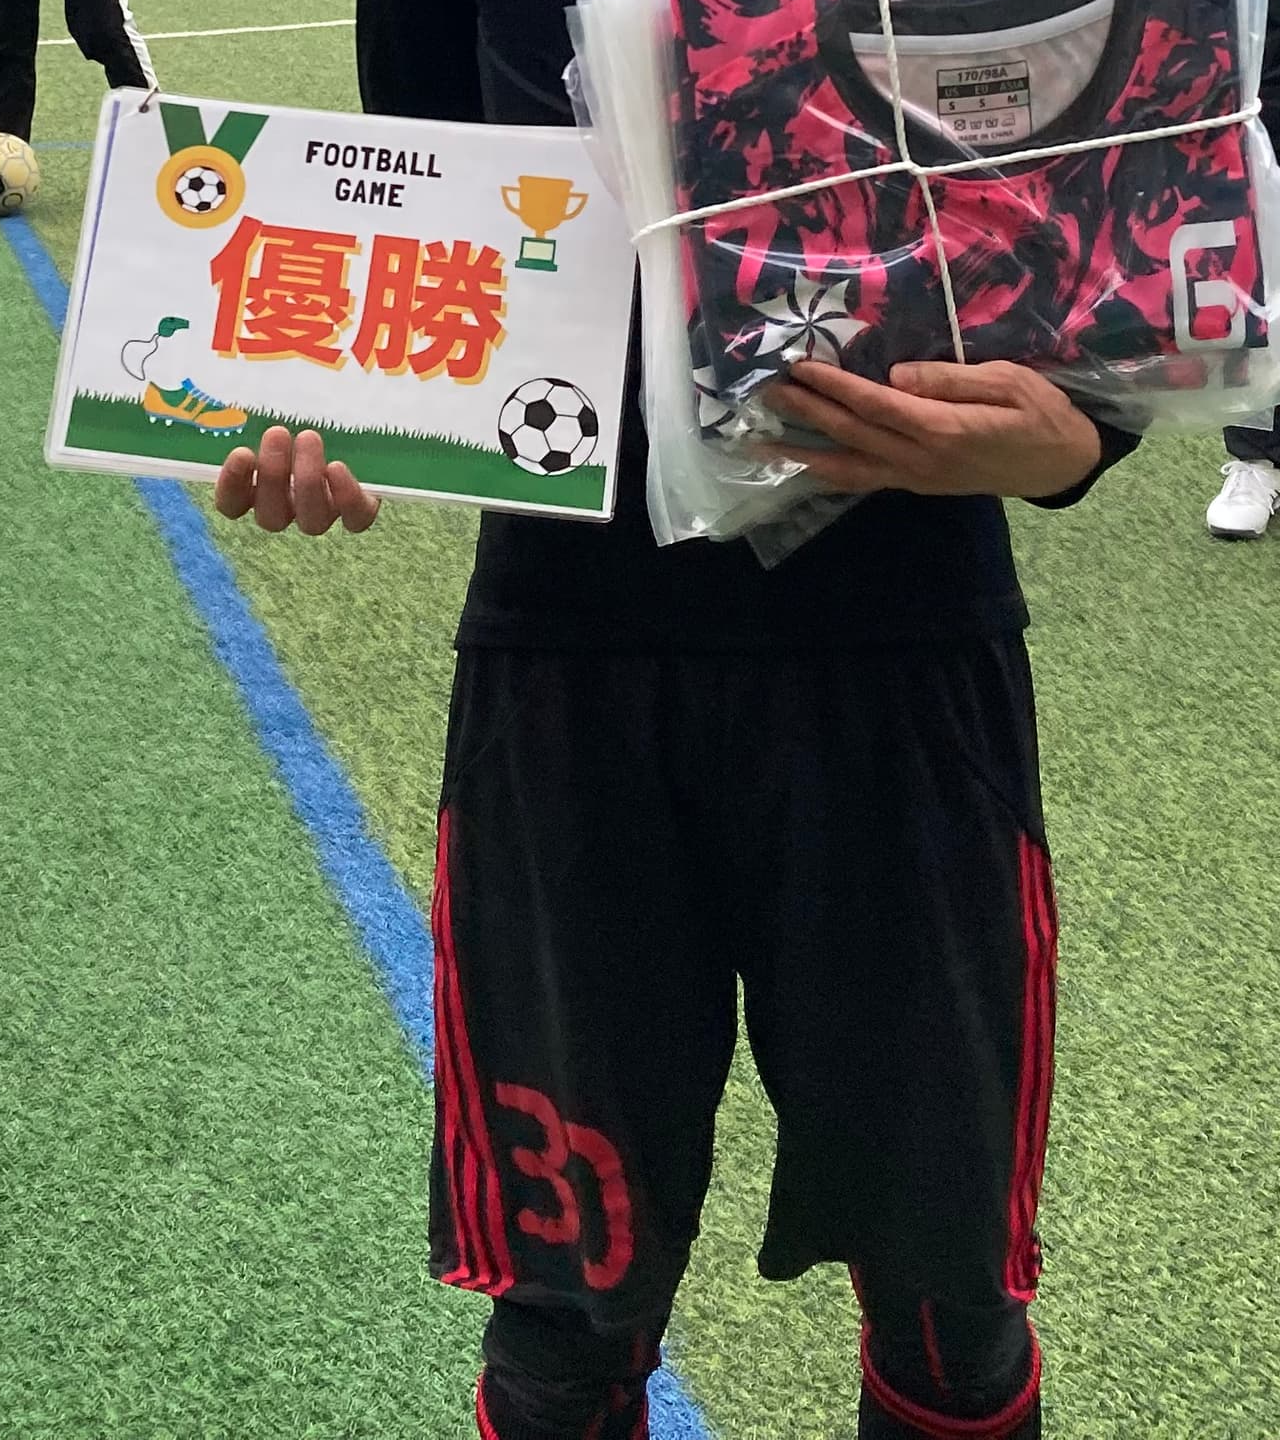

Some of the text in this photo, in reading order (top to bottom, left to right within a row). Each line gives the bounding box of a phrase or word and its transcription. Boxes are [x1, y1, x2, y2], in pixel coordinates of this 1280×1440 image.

[957, 66, 1009, 82] 170/98A
[944, 78, 1025, 97] US EU ASIA
[948, 94, 1018, 111] S S M
[991, 129, 1014, 139] CHINA
[305, 140, 442, 178] FOOTBALL
[335, 178, 405, 208] GAME
[209, 215, 509, 385] 優勝
